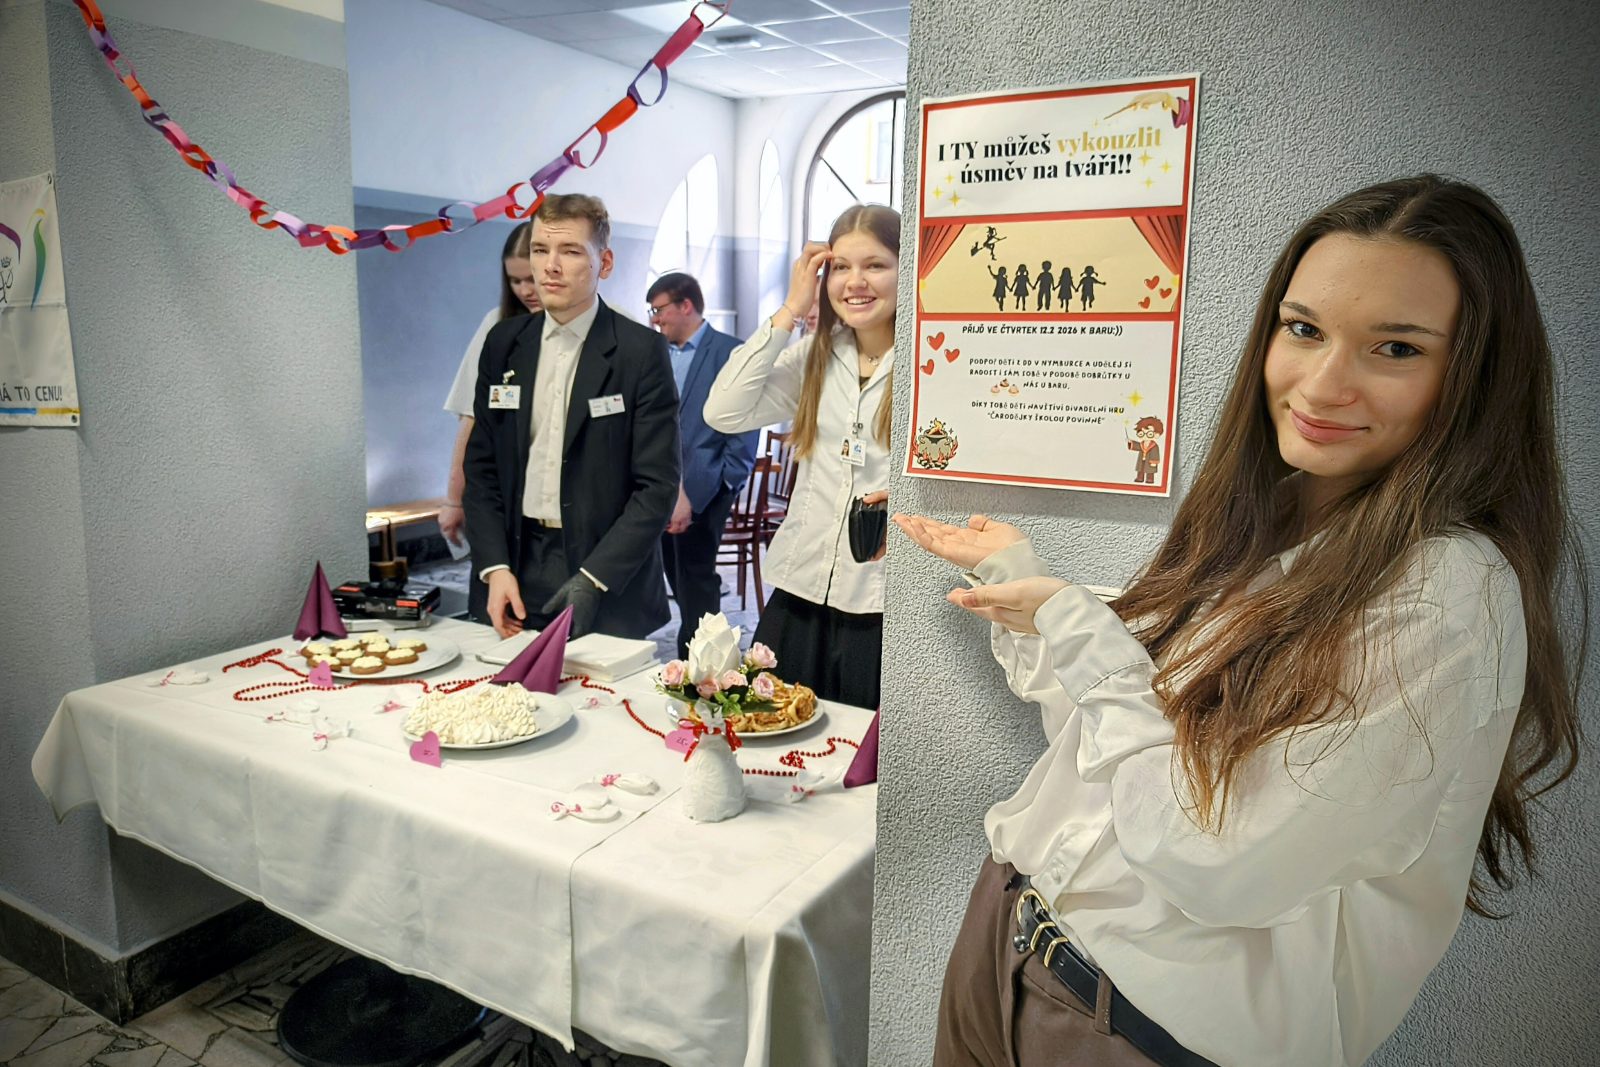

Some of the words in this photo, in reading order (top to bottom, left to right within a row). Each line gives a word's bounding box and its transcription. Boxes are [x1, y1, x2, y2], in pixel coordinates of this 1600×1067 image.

[938, 144, 945, 162] I
[950, 141, 978, 160] TY
[984, 132, 1051, 158] můžeš
[1057, 126, 1161, 157] vykouzlit
[961, 160, 1027, 184] úsměv
[1033, 164, 1058, 180] na
[1065, 153, 1132, 178] tváři!!
[962, 323, 985, 334] PŘIJĎ
[987, 326, 998, 334] VE
[1000, 323, 1038, 334] ČTVRTEK
[1057, 326, 1078, 335] 2026
[1080, 326, 1086, 335] K
[1089, 325, 1123, 336] BARU:))
[1023, 380, 1039, 388] NÁS
[0, 382, 12, 401] Á
[14, 386, 31, 401] TO
[35, 385, 63, 401] CENU!
[1108, 406, 1125, 414] HRU
[1035, 413, 1065, 422] ŠKOLOU
